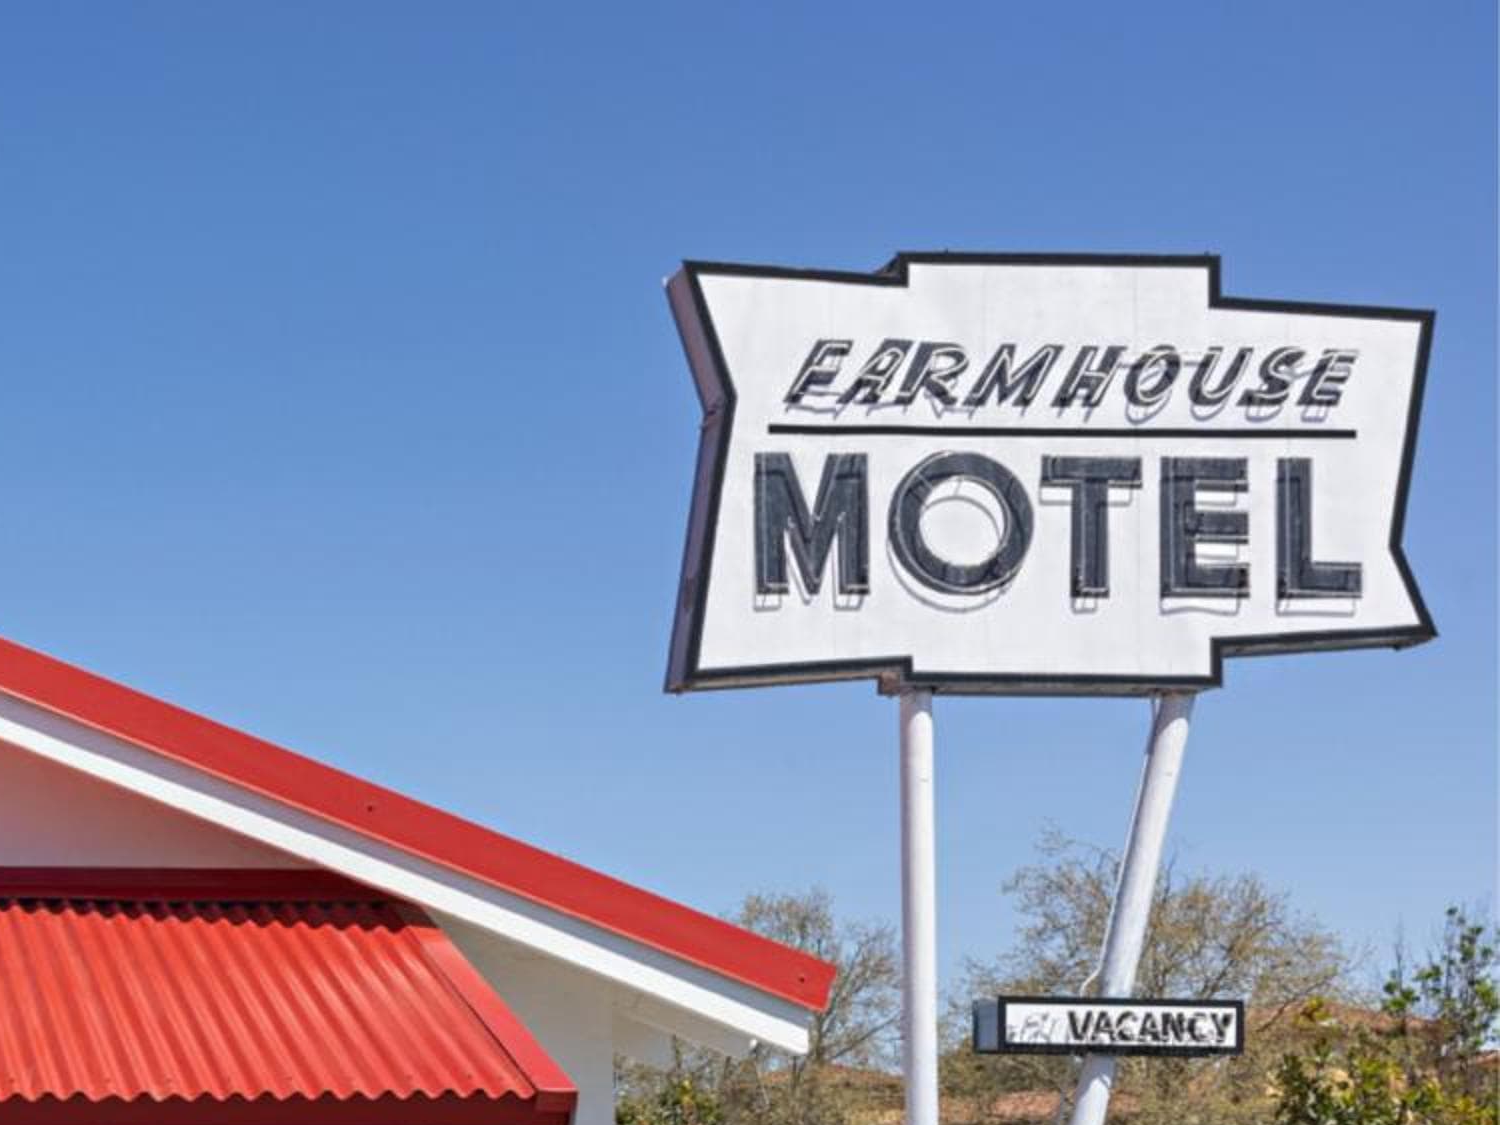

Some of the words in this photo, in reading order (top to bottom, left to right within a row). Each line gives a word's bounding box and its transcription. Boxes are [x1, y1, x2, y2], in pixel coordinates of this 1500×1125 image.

[783, 338, 1358, 414] FARMHOUSE
[752, 451, 1364, 606] MOTEL
[1067, 1010, 1233, 1044] VACANCY
